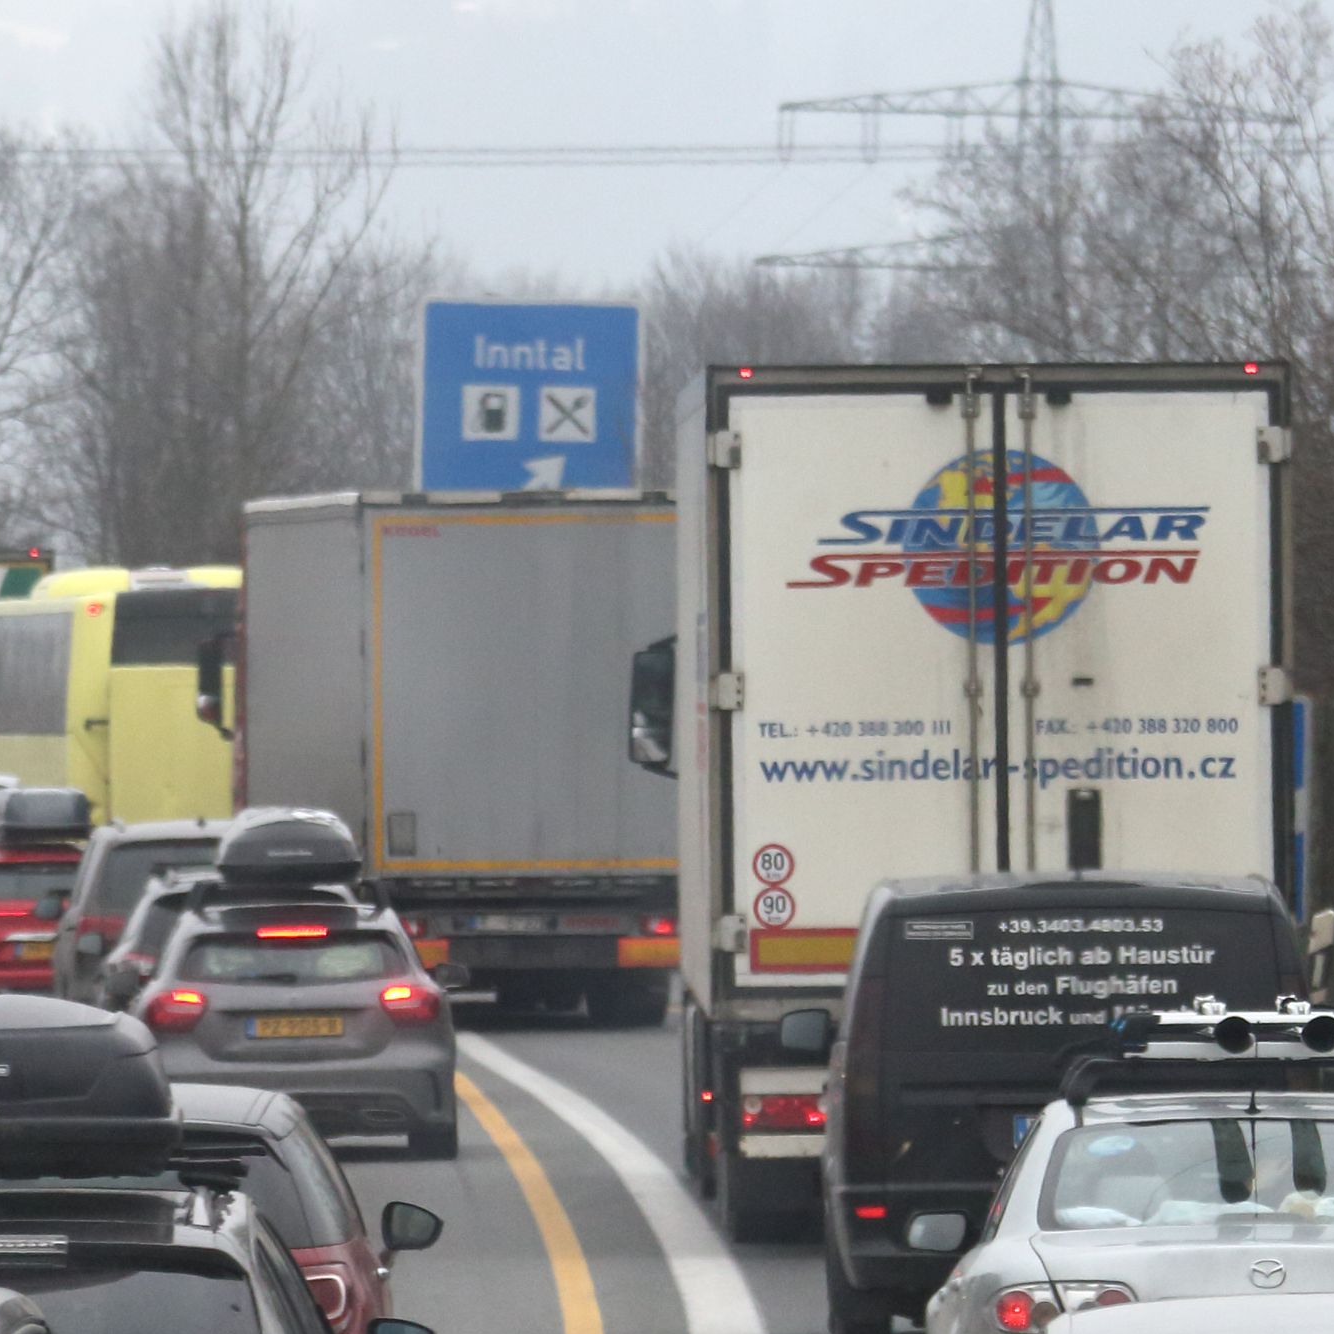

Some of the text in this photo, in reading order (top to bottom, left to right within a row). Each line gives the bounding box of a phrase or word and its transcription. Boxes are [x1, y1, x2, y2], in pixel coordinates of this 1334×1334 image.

[473, 335, 586, 371] Inntal
[817, 506, 1210, 546] SINDELAR
[786, 550, 1200, 589] SPEDITION
[759, 722, 799, 738] TEL.:
[806, 720, 853, 737] +420
[858, 720, 888, 737] 388
[893, 720, 925, 736] 300
[1086, 718, 1132, 734] +420
[1138, 718, 1167, 734] 388
[1172, 718, 1201, 733] 320
[1207, 718, 1239, 733] 800
[760, 748, 1237, 789] www.sindelar-spedition.cz
[761, 852, 785, 871] 80
[762, 895, 786, 915] 90
[949, 945, 1215, 970] 5 x täglich ab Haustür
[987, 975, 1178, 999] zu den Flughäfen
[940, 1006, 1063, 1027] Innsbruck
[1069, 1009, 1106, 1025] und
